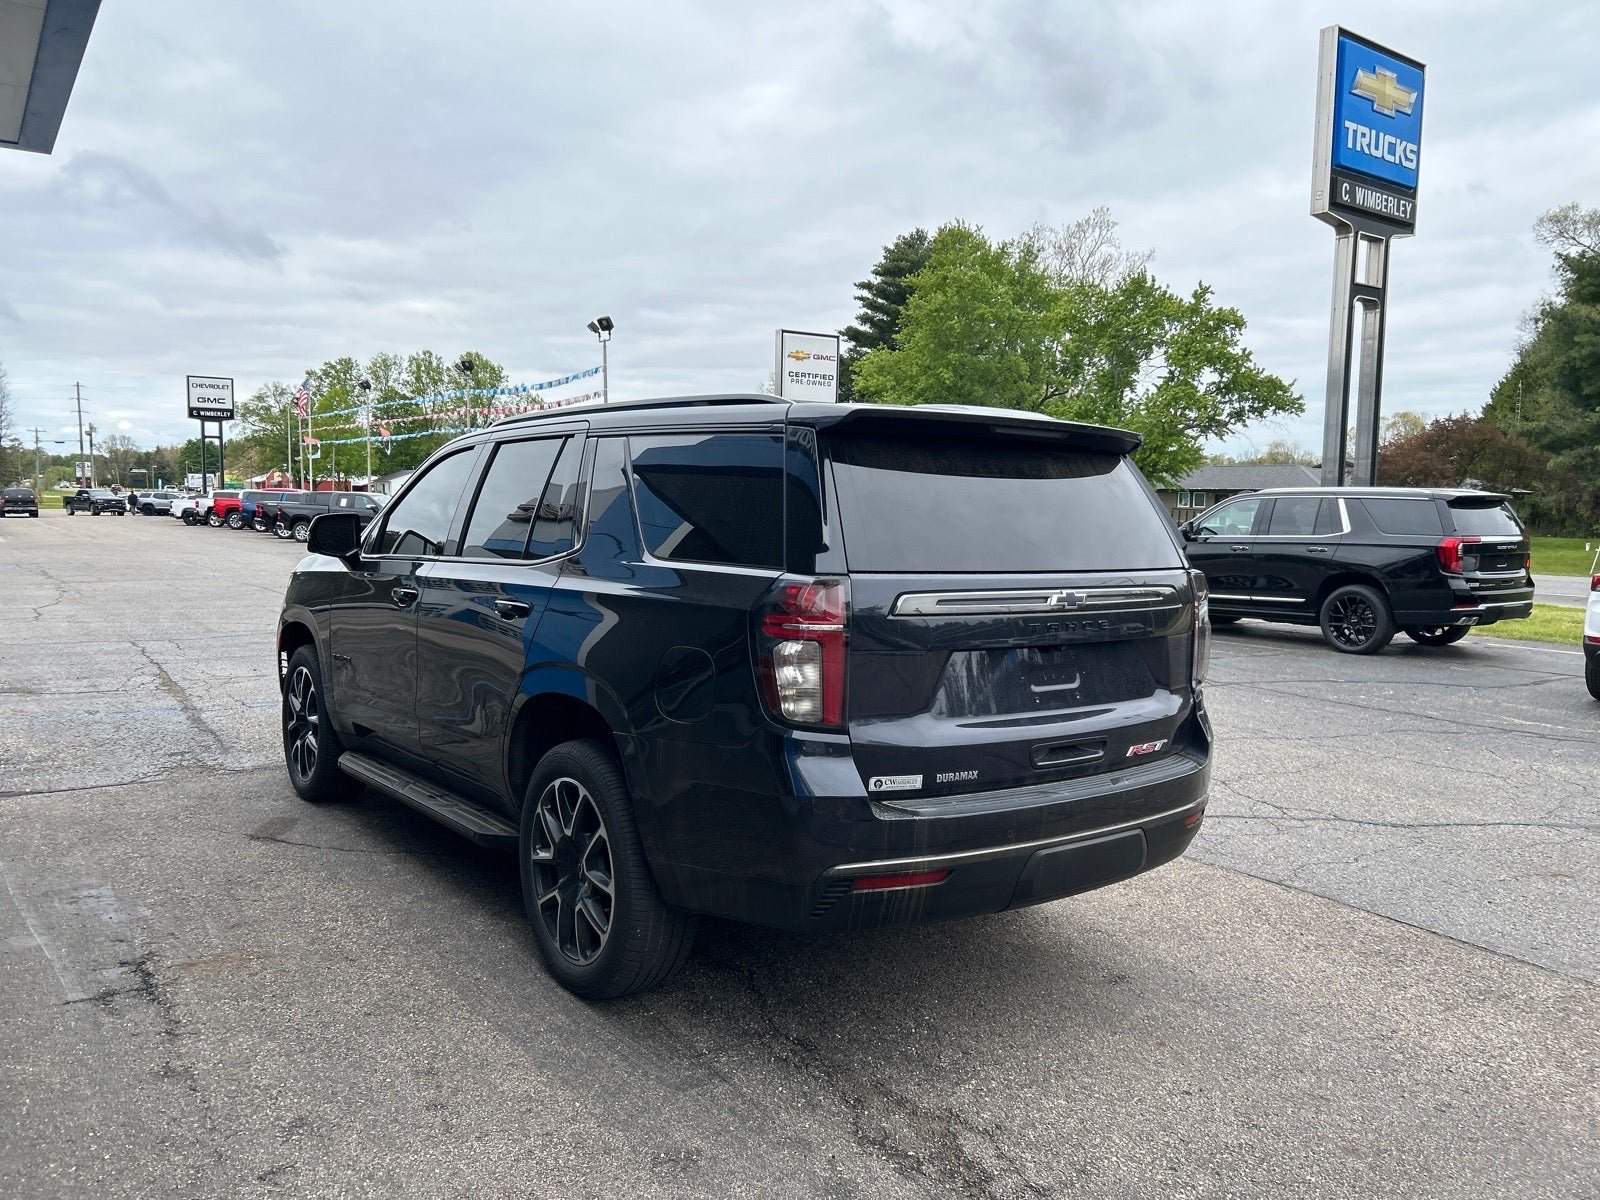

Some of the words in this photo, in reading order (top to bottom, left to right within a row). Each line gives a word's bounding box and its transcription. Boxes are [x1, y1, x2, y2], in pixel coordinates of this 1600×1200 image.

[1344, 120, 1418, 170] TRUCKS
[1342, 182, 1350, 203] C.
[1355, 186, 1413, 219] WIMBERLEY
[812, 354, 836, 362] GMC
[788, 370, 834, 381] CERTIFIED
[191, 382, 230, 390] CHEVROLET
[790, 378, 832, 387] PRE-OWNED
[197, 396, 226, 405] GMC
[1126, 739, 1168, 757] RST
[936, 770, 979, 783] DURAMAX
